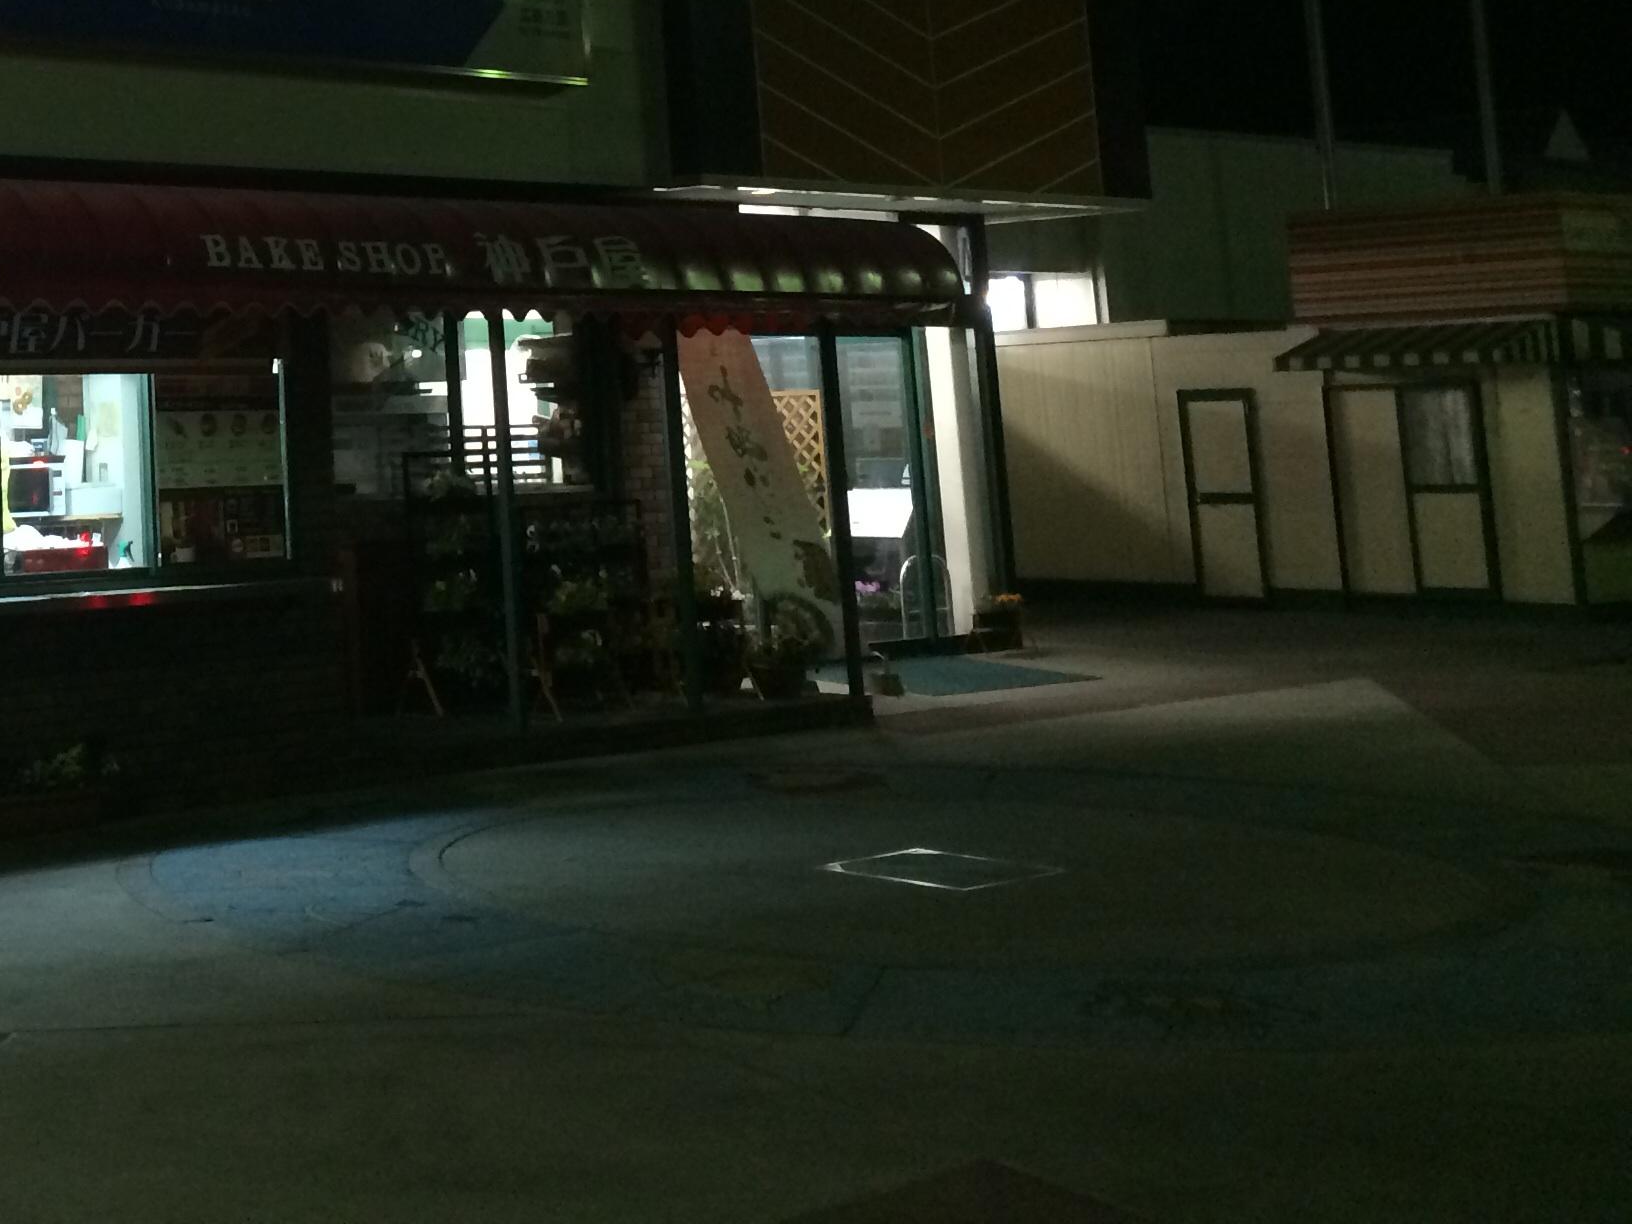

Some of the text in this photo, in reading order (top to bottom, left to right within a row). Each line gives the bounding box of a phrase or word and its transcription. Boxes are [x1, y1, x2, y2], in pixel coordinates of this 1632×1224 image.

[200, 233, 450, 276] BAKE SHOP
[474, 232, 646, 288] 神戸屋
